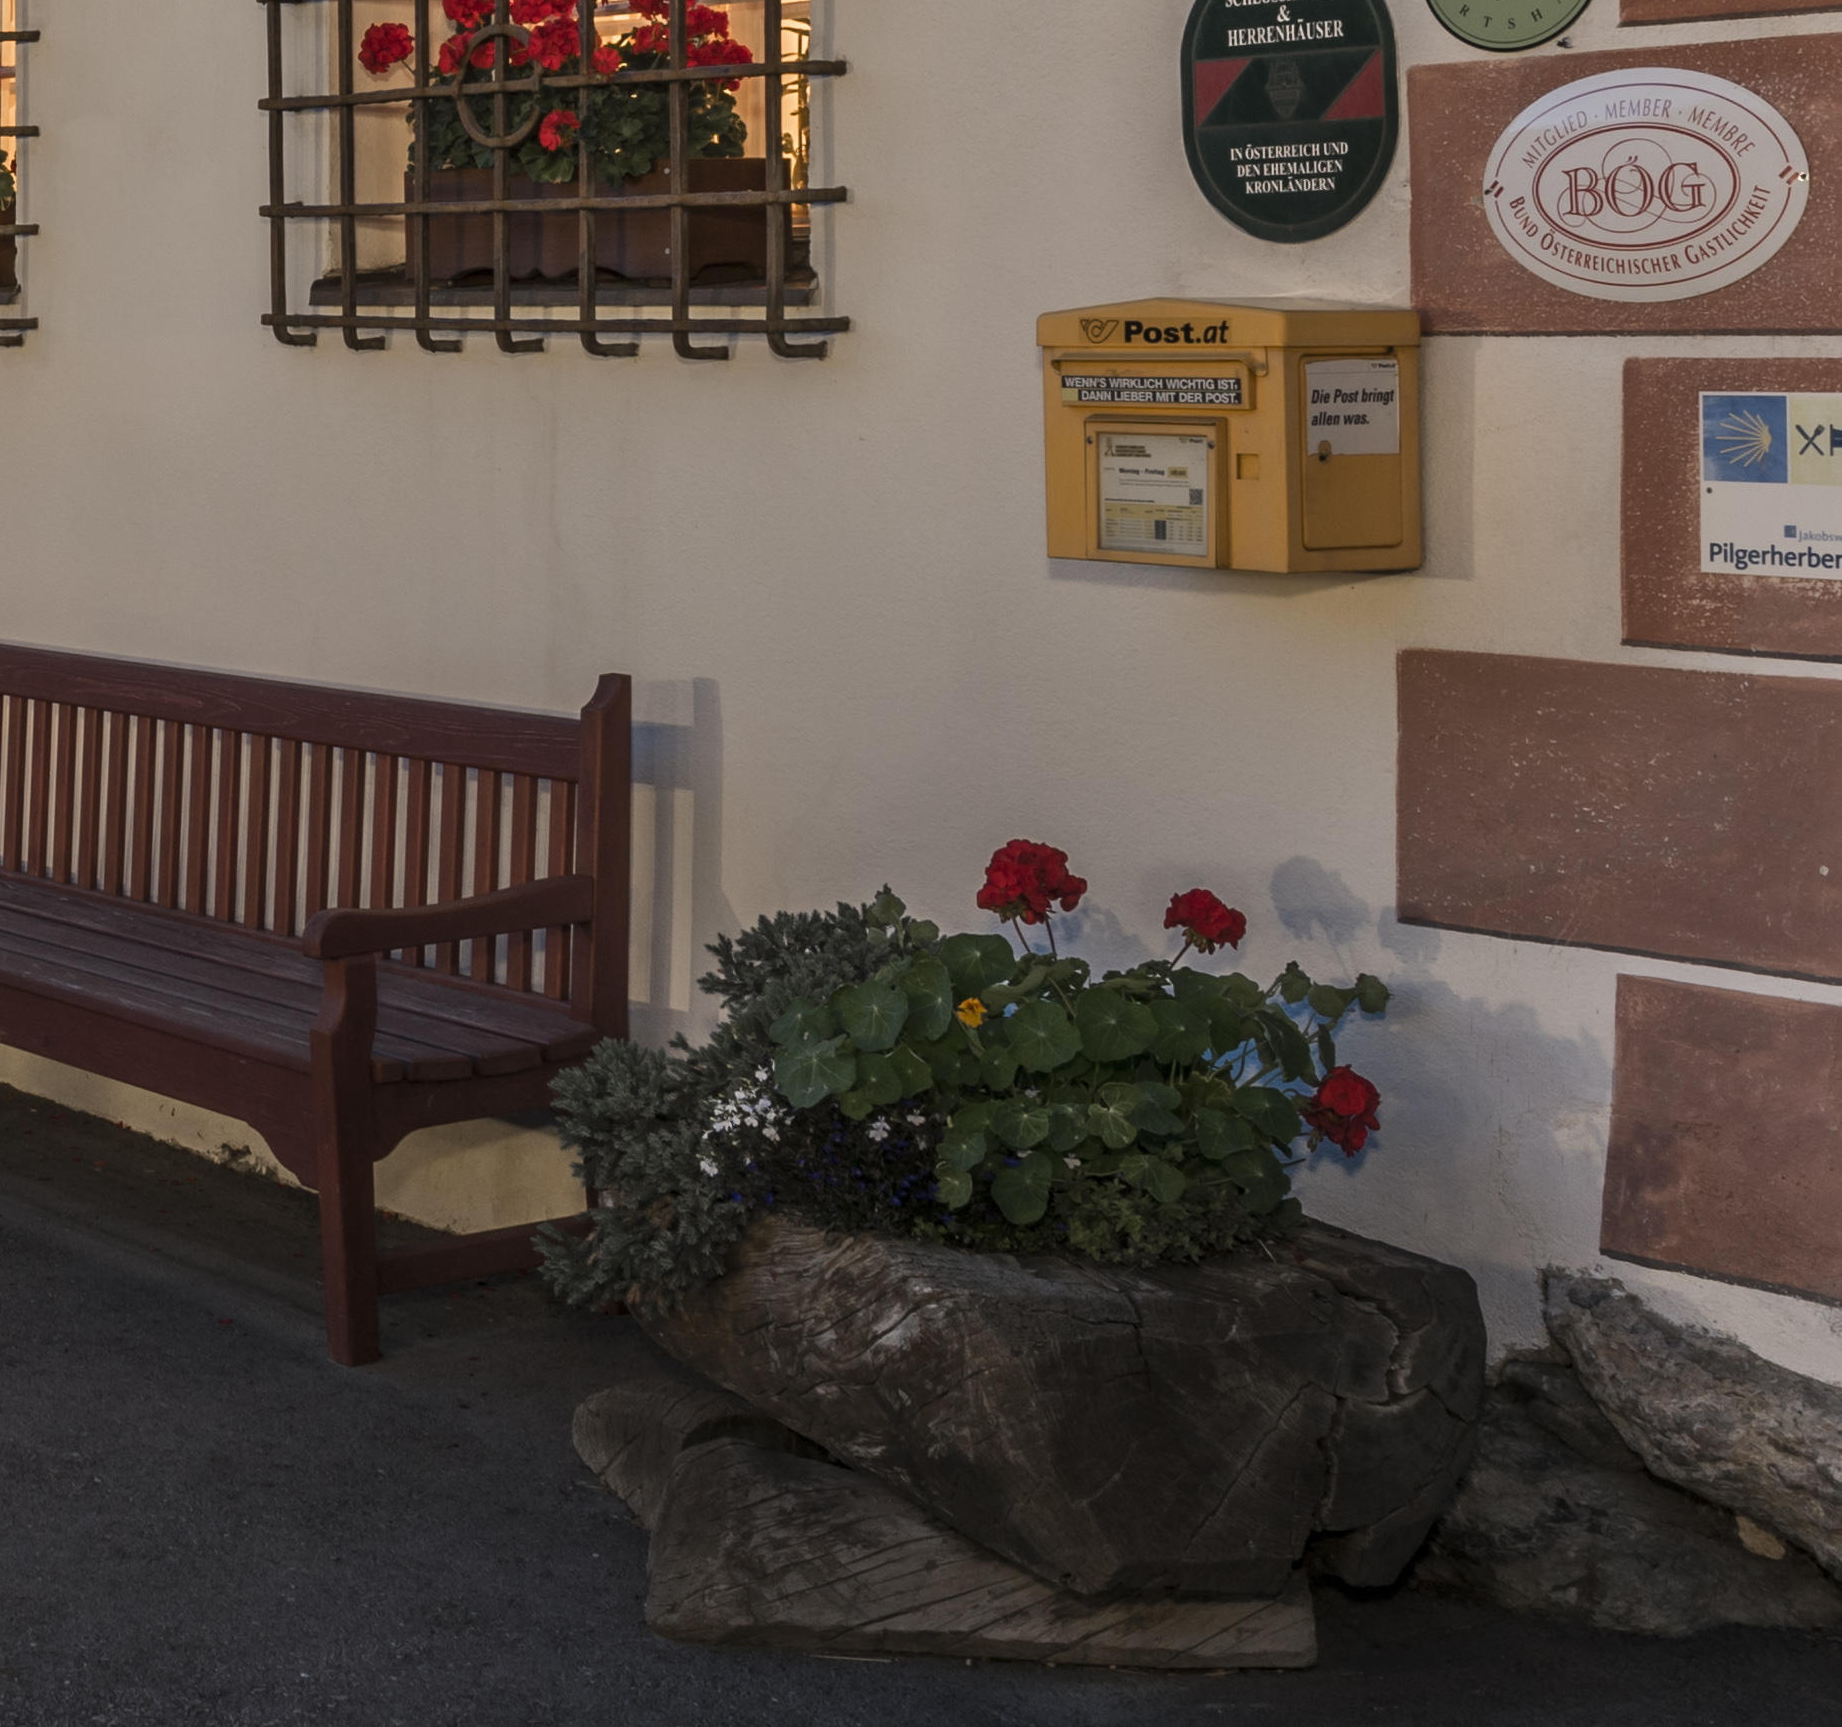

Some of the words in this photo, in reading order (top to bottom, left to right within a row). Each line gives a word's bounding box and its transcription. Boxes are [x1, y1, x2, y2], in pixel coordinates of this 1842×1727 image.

[1276, 5, 1291, 23] &
[1227, 19, 1344, 47] HERRENHÄUSER
[1521, 110, 1588, 169] MITGLIED
[1604, 98, 1672, 120] MEMBER
[1687, 105, 1756, 158] MEMBRE
[1230, 148, 1243, 161] IN
[1245, 144, 1320, 160] ÖSTERREICH
[1323, 142, 1348, 155] UND
[1237, 164, 1260, 177] DEN
[1263, 160, 1343, 176] EHEMALIGEN
[1245, 176, 1336, 194] KRONLÄNDERN
[1561, 155, 1707, 218] BÖG
[1509, 195, 1538, 238] BUND
[1540, 229, 1682, 274] ÖSTERREICHISCHER
[1684, 184, 1771, 264] GASTLICHKEIT
[1124, 320, 1229, 344] Post.at
[1064, 377, 1106, 388] WENN'S
[1109, 377, 1163, 389] WIRKLICH
[1165, 378, 1215, 390] WICHTIG
[1081, 390, 1112, 401] DANN
[1114, 391, 1154, 402] LIEBER
[1155, 391, 1176, 402] MIT
[1179, 392, 1203, 403] DER
[1205, 392, 1238, 403] POST.
[1311, 389, 1330, 404] Die
[1333, 388, 1359, 404] Post
[1361, 388, 1394, 405] bringt
[1311, 412, 1340, 426] allen
[1343, 414, 1369, 426] was.
